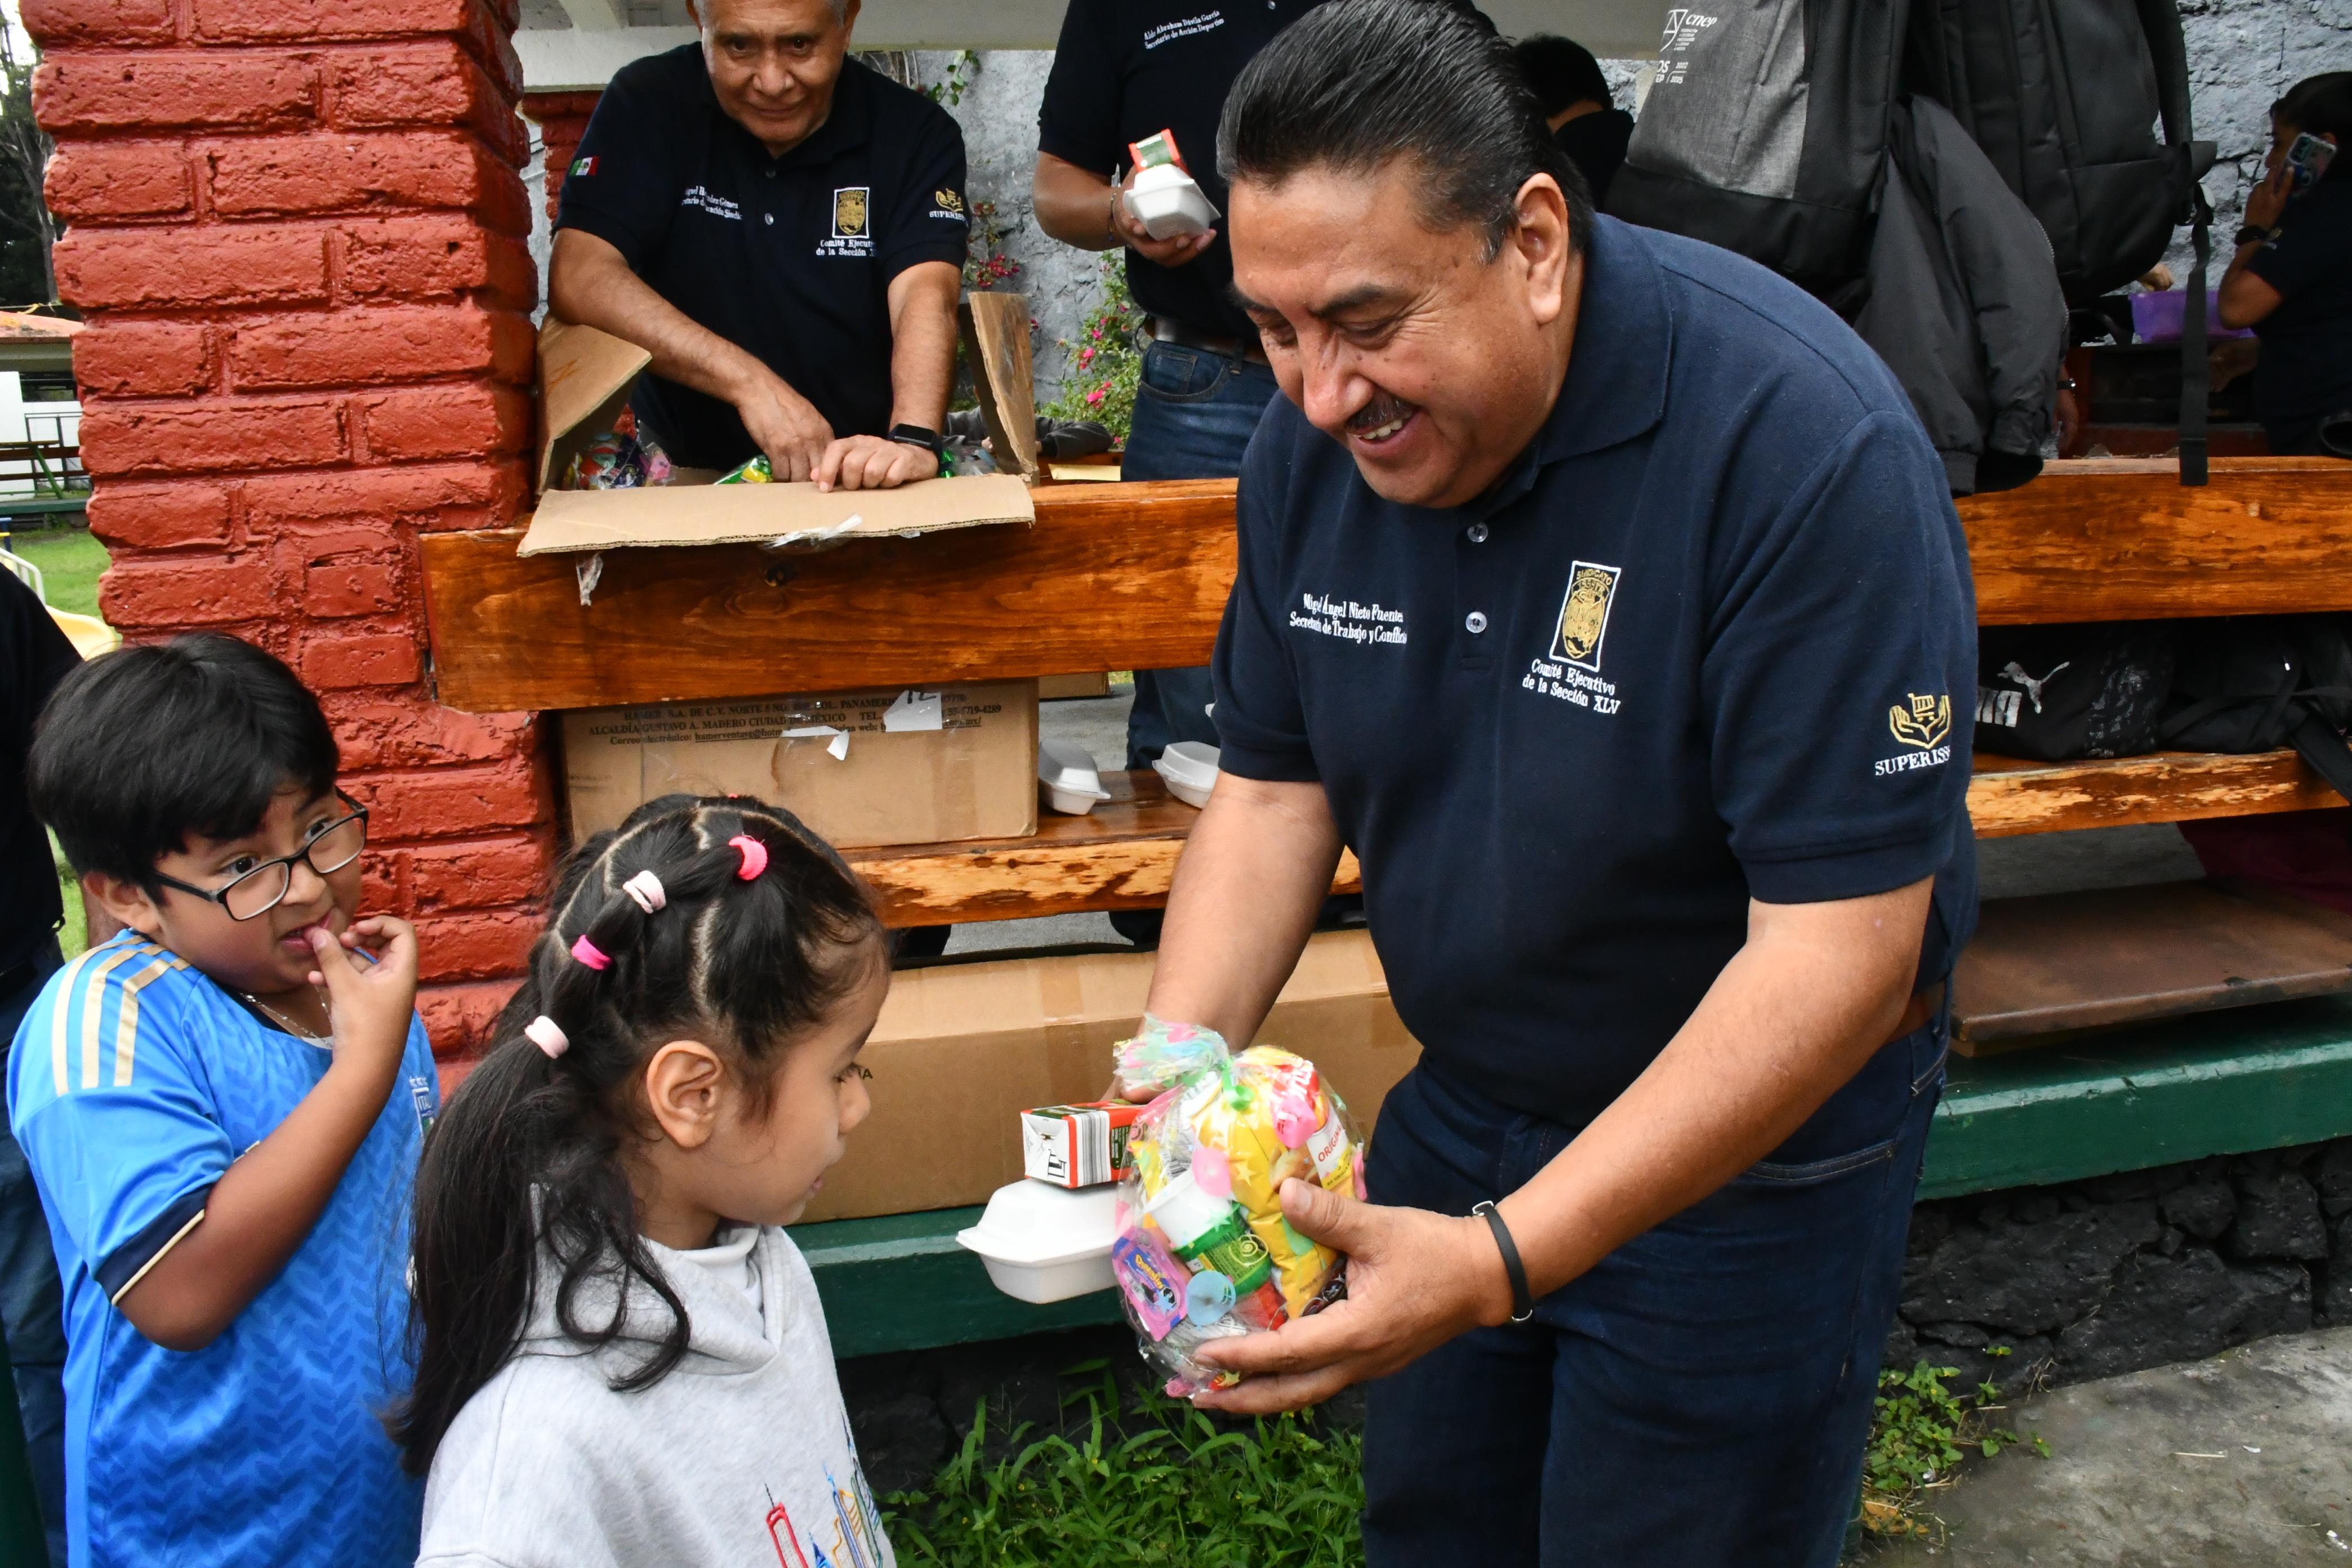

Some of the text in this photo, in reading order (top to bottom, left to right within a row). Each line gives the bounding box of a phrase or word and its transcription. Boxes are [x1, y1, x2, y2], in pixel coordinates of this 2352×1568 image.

[820, 239, 845, 247] Comité
[839, 247, 866, 256] Sección
[1322, 594, 1346, 620] Ángel
[1349, 602, 1370, 620] Nieto
[1322, 618, 1332, 635] de
[1332, 620, 1367, 644] Trabajo
[1369, 630, 1374, 644] y
[1531, 658, 1616, 696] Comité Ejecutivo
[1522, 674, 1621, 714] de la Sección XLV
[689, 707, 705, 717] DE
[729, 703, 763, 715] NORTE
[589, 723, 640, 736] ALCALDÍA
[643, 721, 686, 733] GUSTAVO
[702, 718, 746, 729] MADERO
[749, 716, 786, 727] CIUDAD
[859, 711, 883, 721] TEL.
[610, 737, 640, 745] Correo
[695, 727, 782, 742] hamerventasg@hotm
